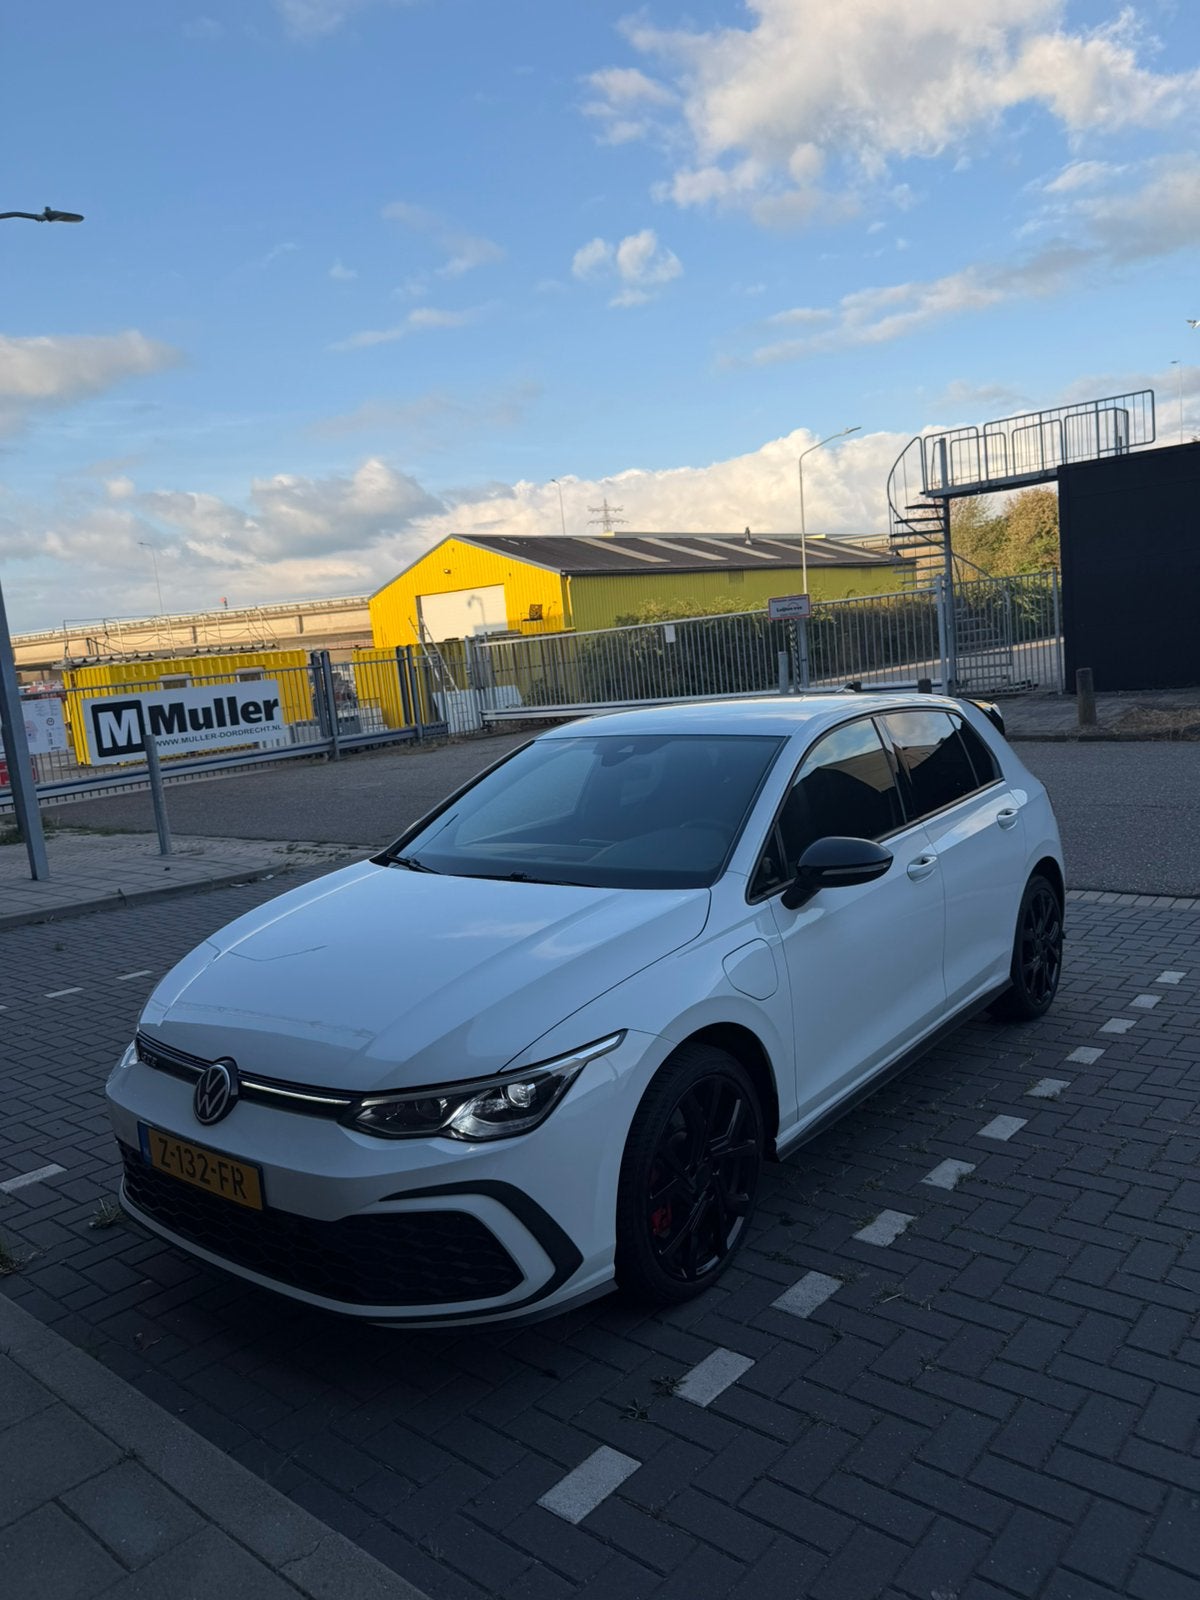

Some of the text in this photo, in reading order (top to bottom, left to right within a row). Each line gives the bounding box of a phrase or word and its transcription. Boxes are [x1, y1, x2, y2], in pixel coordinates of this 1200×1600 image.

[98, 697, 280, 748] M Muller
[158, 1137, 247, 1199] Z-132-FR
